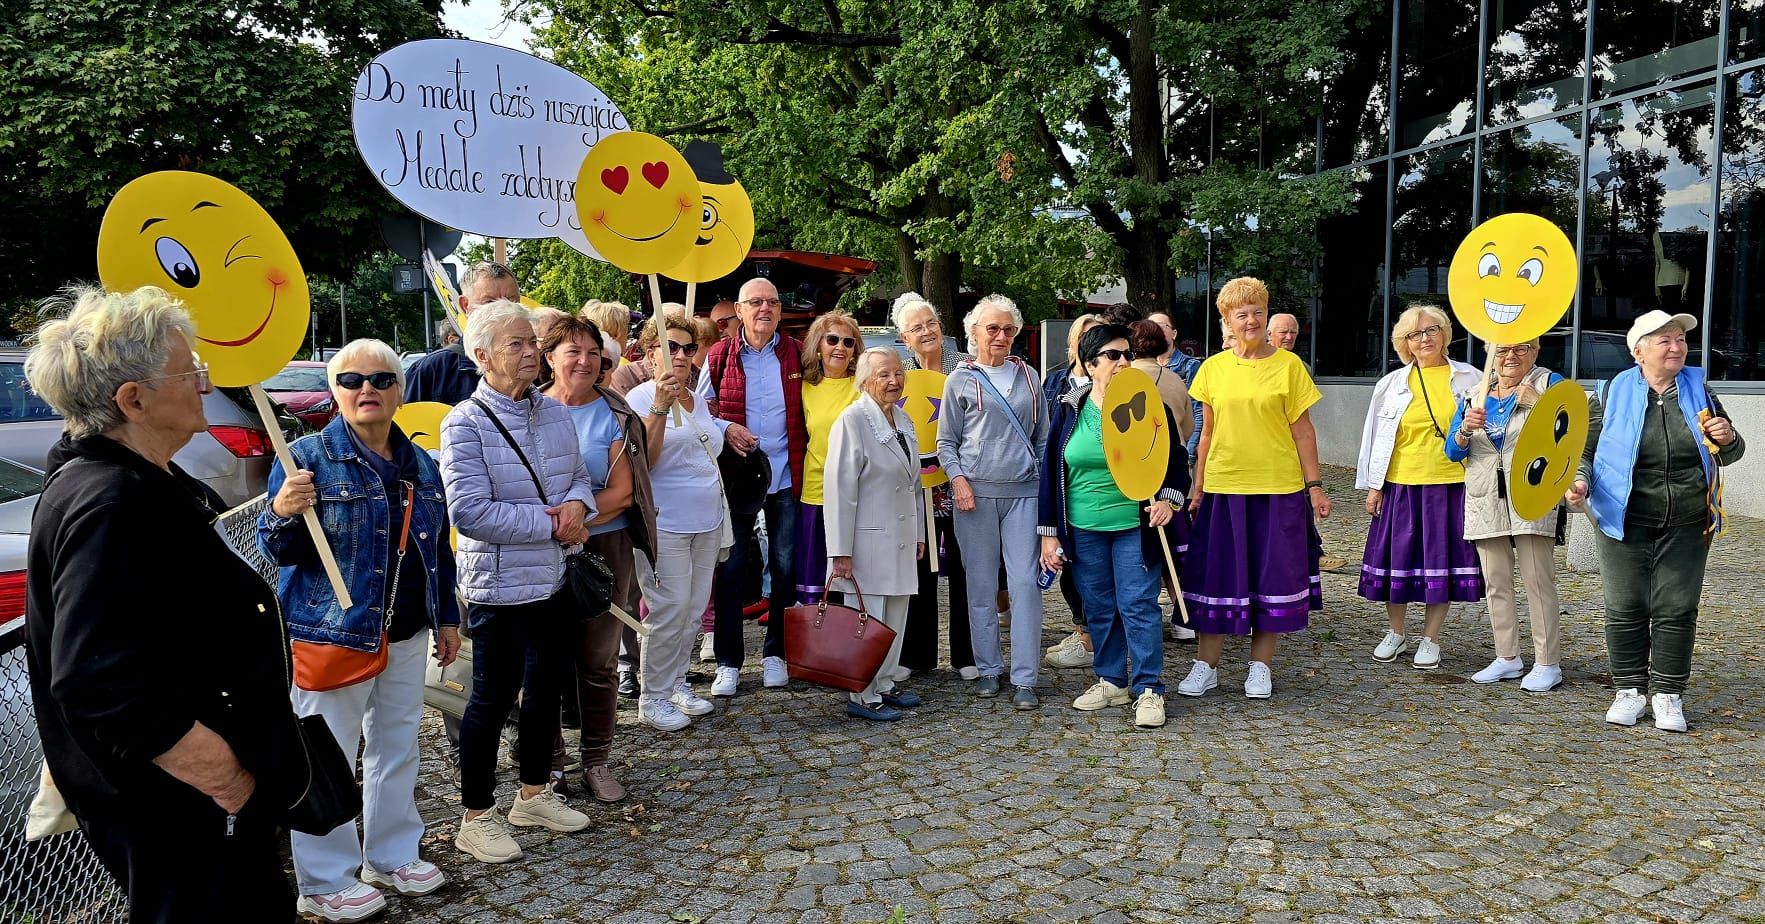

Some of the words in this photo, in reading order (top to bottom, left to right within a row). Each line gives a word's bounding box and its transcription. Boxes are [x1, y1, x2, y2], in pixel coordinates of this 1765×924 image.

[355, 62, 405, 104] Do
[418, 57, 477, 138] mety
[489, 63, 535, 119] dziś
[543, 97, 627, 147] ruszajcie
[380, 128, 486, 193] Medale
[499, 144, 582, 230] zdobyw
